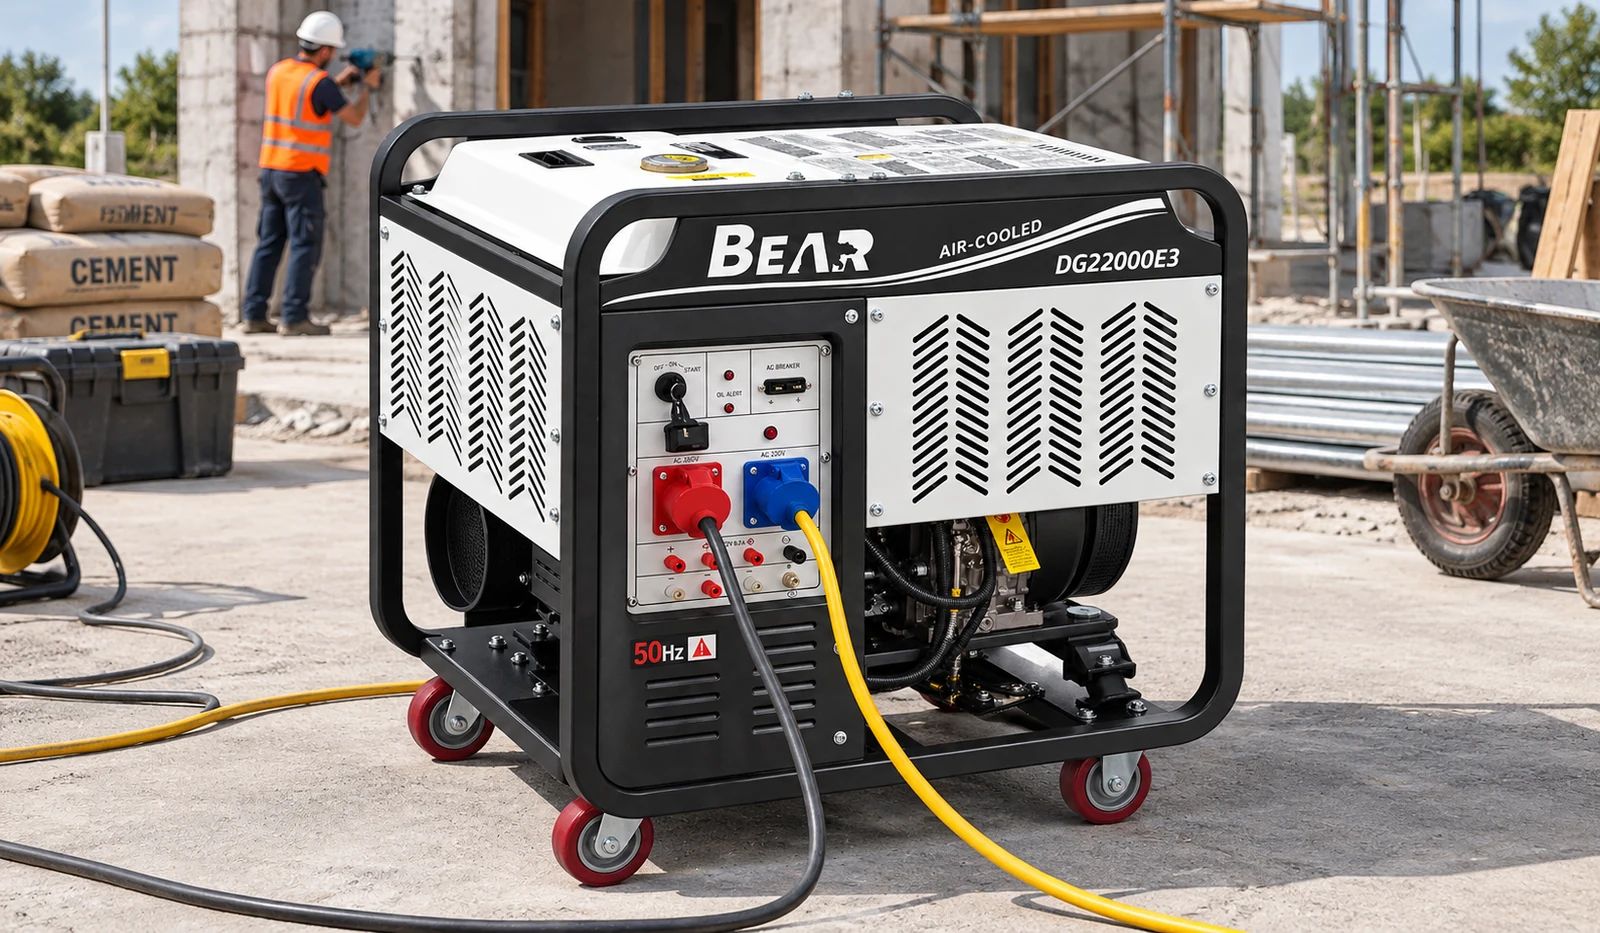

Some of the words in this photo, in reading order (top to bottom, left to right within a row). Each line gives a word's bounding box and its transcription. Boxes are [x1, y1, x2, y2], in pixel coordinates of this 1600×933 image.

[707, 224, 874, 278] BEAR
[939, 219, 1042, 259] AIR-COOLED
[71, 255, 178, 285] CEMENT
[1055, 248, 1180, 275] DG22000E3
[70, 313, 178, 335] CEMENT
[653, 363, 664, 371] OFF
[775, 362, 801, 370] BREAKER
[634, 640, 684, 665] 50Hz
